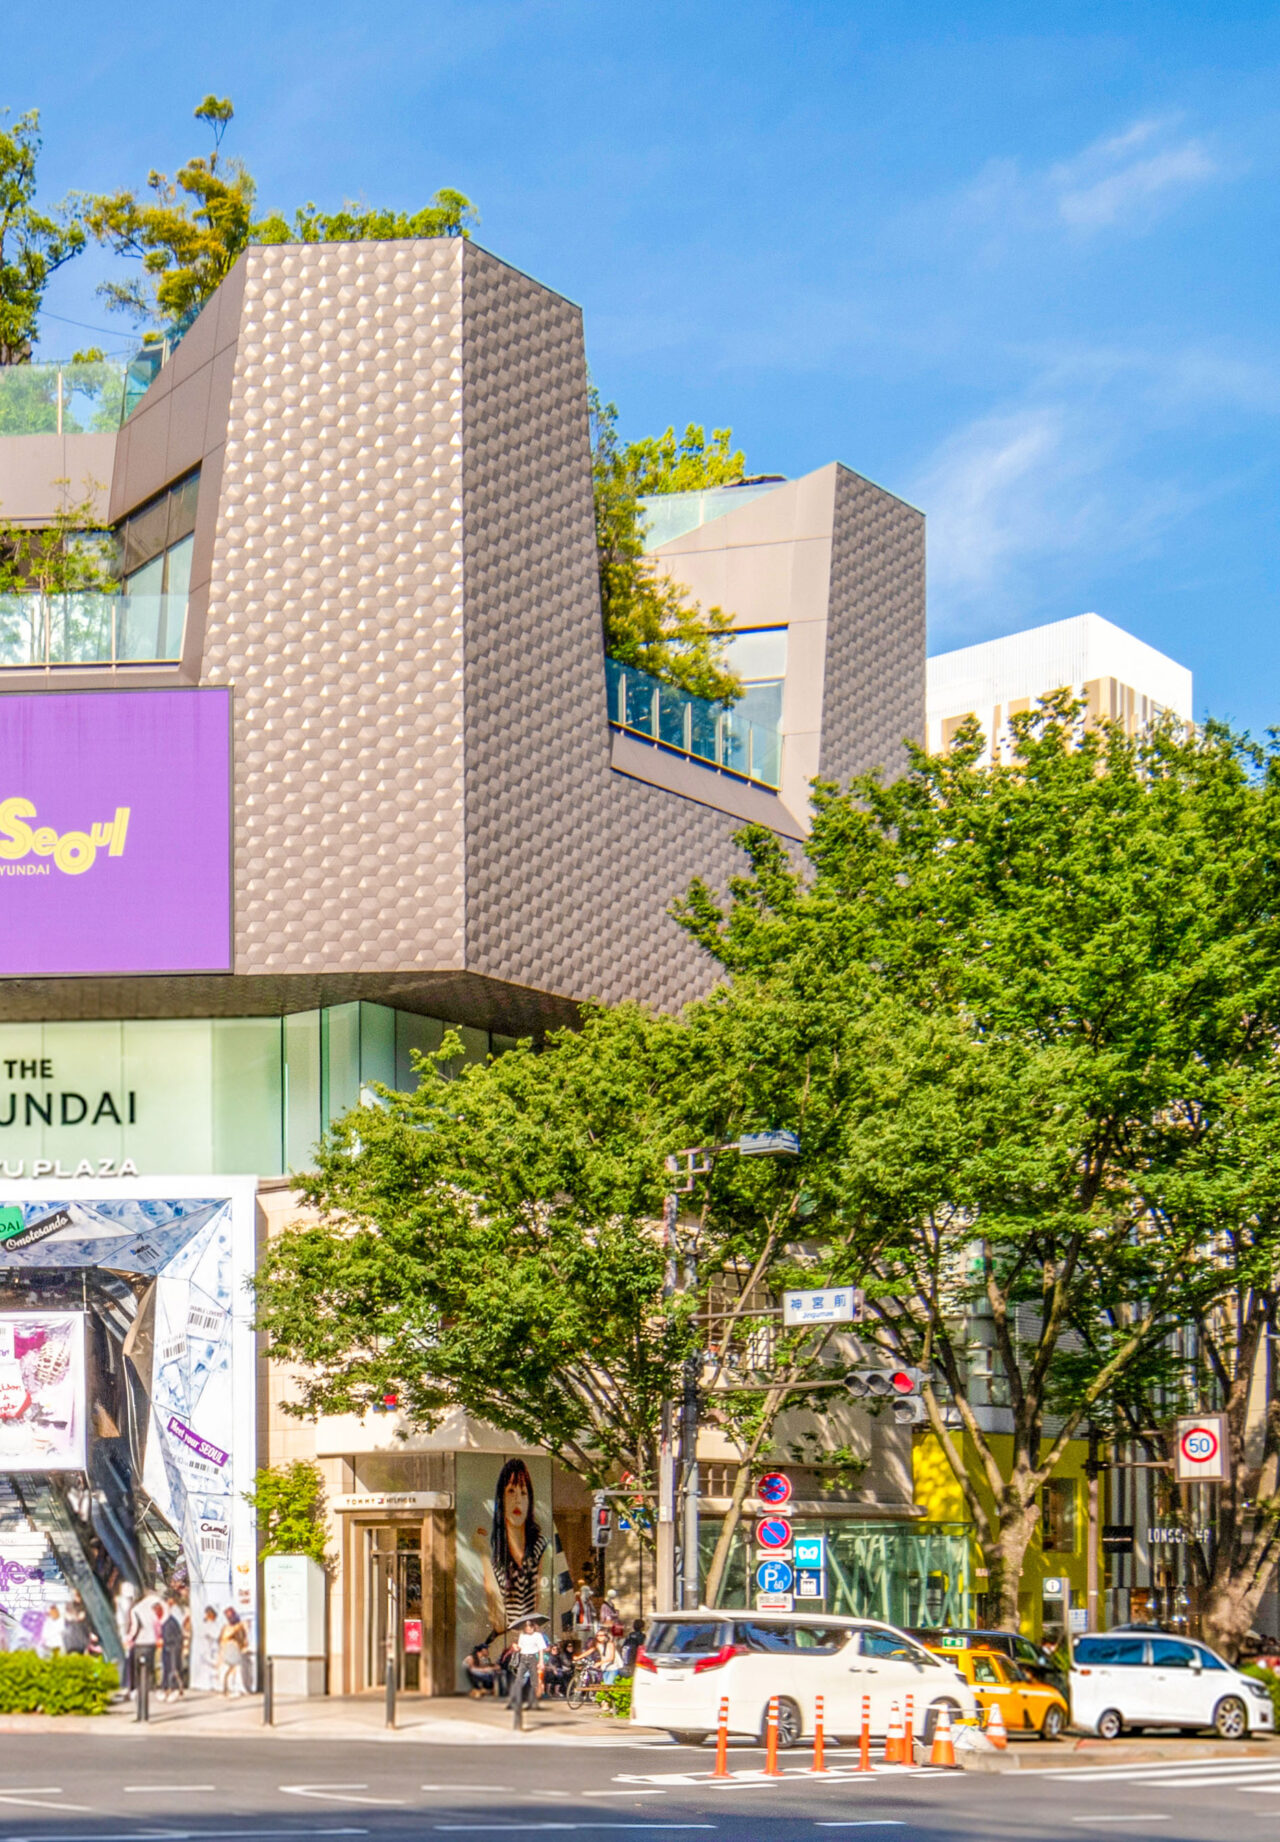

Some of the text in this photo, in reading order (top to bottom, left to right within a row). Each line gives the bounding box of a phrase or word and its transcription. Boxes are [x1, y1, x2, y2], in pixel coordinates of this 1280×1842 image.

[3, 1059, 53, 1079] THE
[32, 1157, 139, 1179] PLAZA
[6, 1214, 68, 1250] Omotesando
[790, 1294, 846, 1311] 神宮前
[170, 1419, 185, 1438] Meet
[183, 1433, 200, 1449] your
[199, 1442, 224, 1464] SEOUL
[1189, 1438, 1210, 1453] 50
[201, 1523, 228, 1536] Camel
[765, 1569, 778, 1589] P
